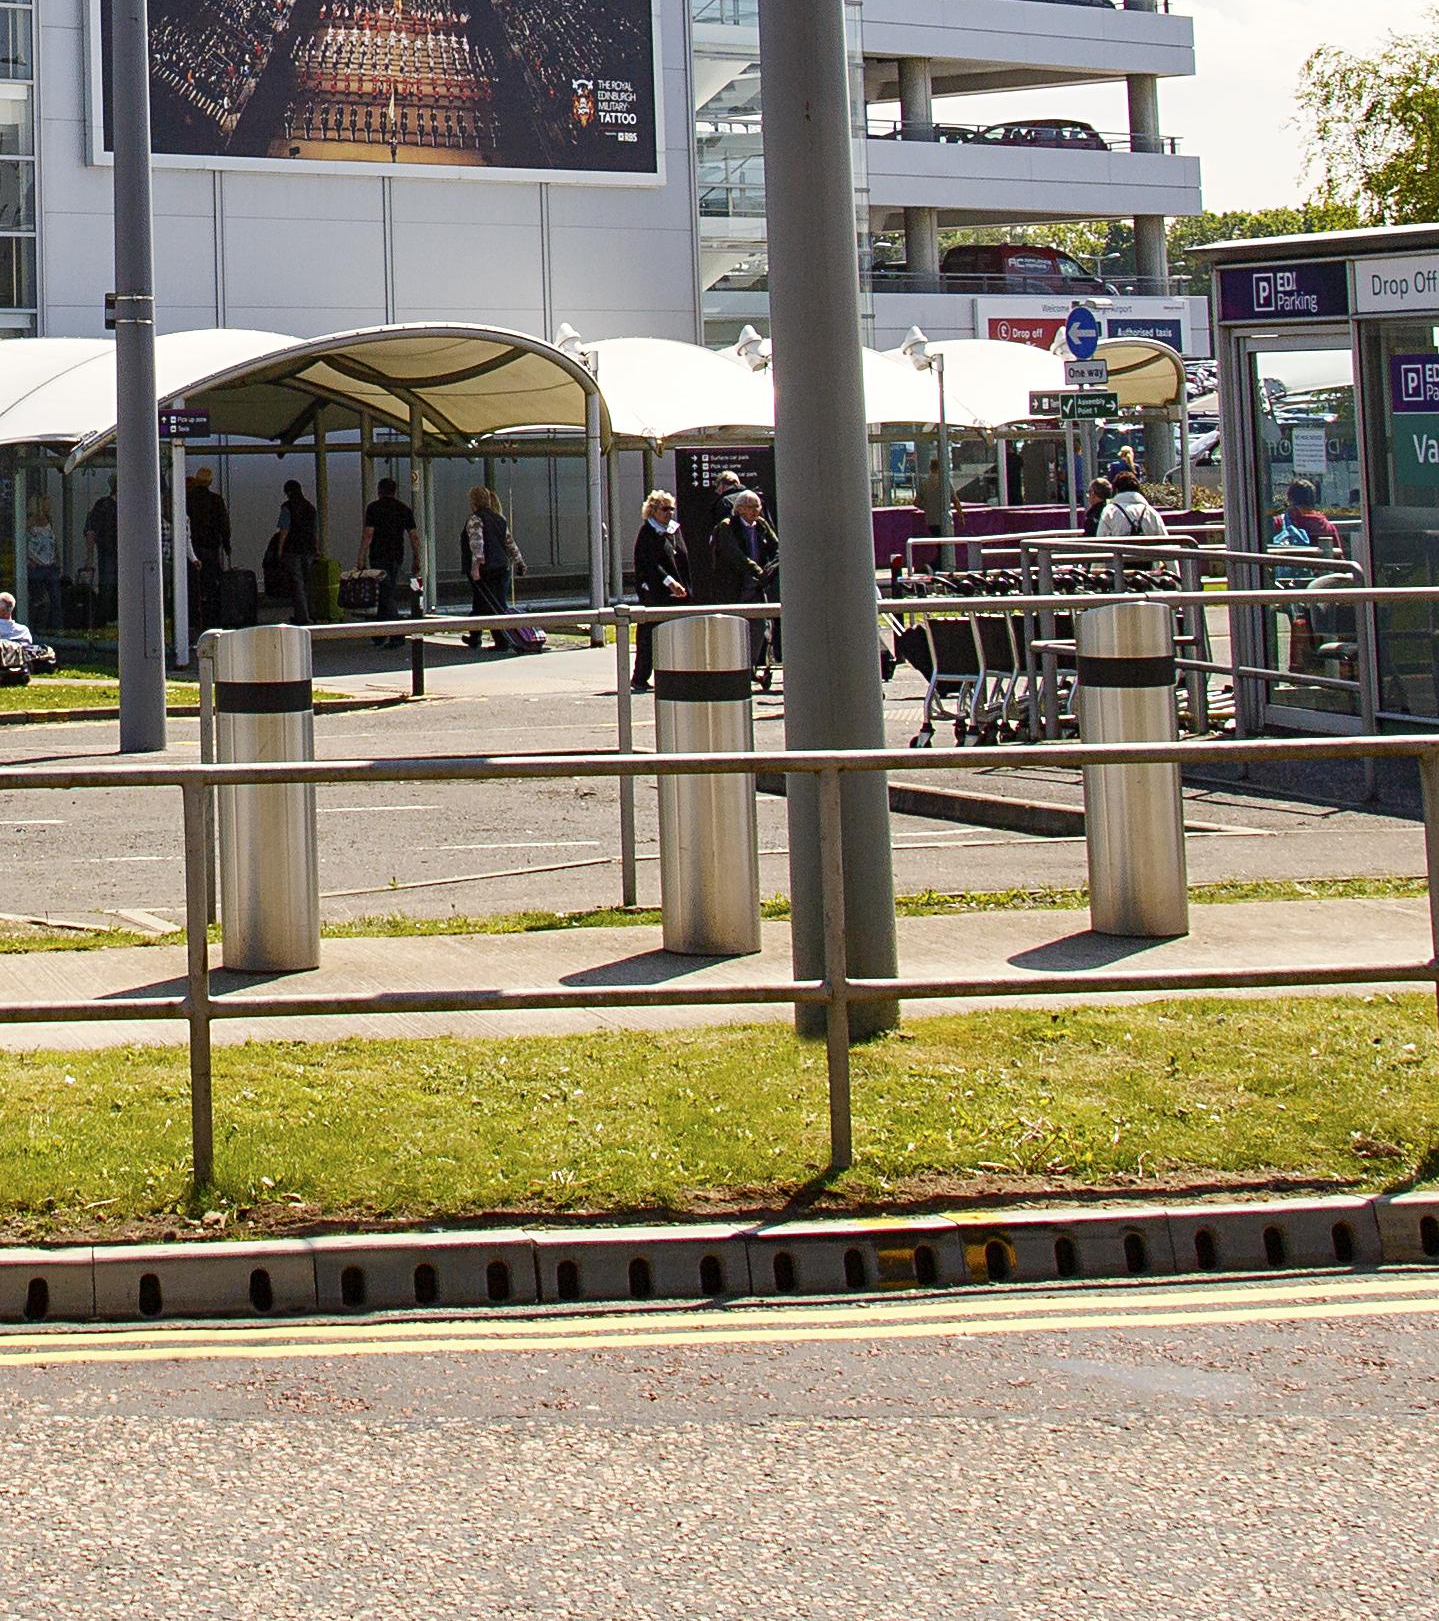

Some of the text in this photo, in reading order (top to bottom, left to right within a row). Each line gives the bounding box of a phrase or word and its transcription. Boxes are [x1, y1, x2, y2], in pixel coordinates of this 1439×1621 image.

[597, 80, 634, 91] THE ROYAL
[597, 91, 637, 102] EDINBURGH
[598, 112, 637, 125] TATTOO
[1371, 274, 1409, 299] Drop
[1414, 270, 1438, 293] Off
[1259, 282, 1269, 305] P
[1277, 291, 1318, 313] Parking
[1012, 328, 1030, 338] Drop
[1032, 328, 1043, 337] off
[1117, 328, 1172, 338] Authorised taxis
[1068, 368, 1104, 378] One way
[1408, 372, 1418, 394] P
[1077, 398, 1106, 406] Assembly
